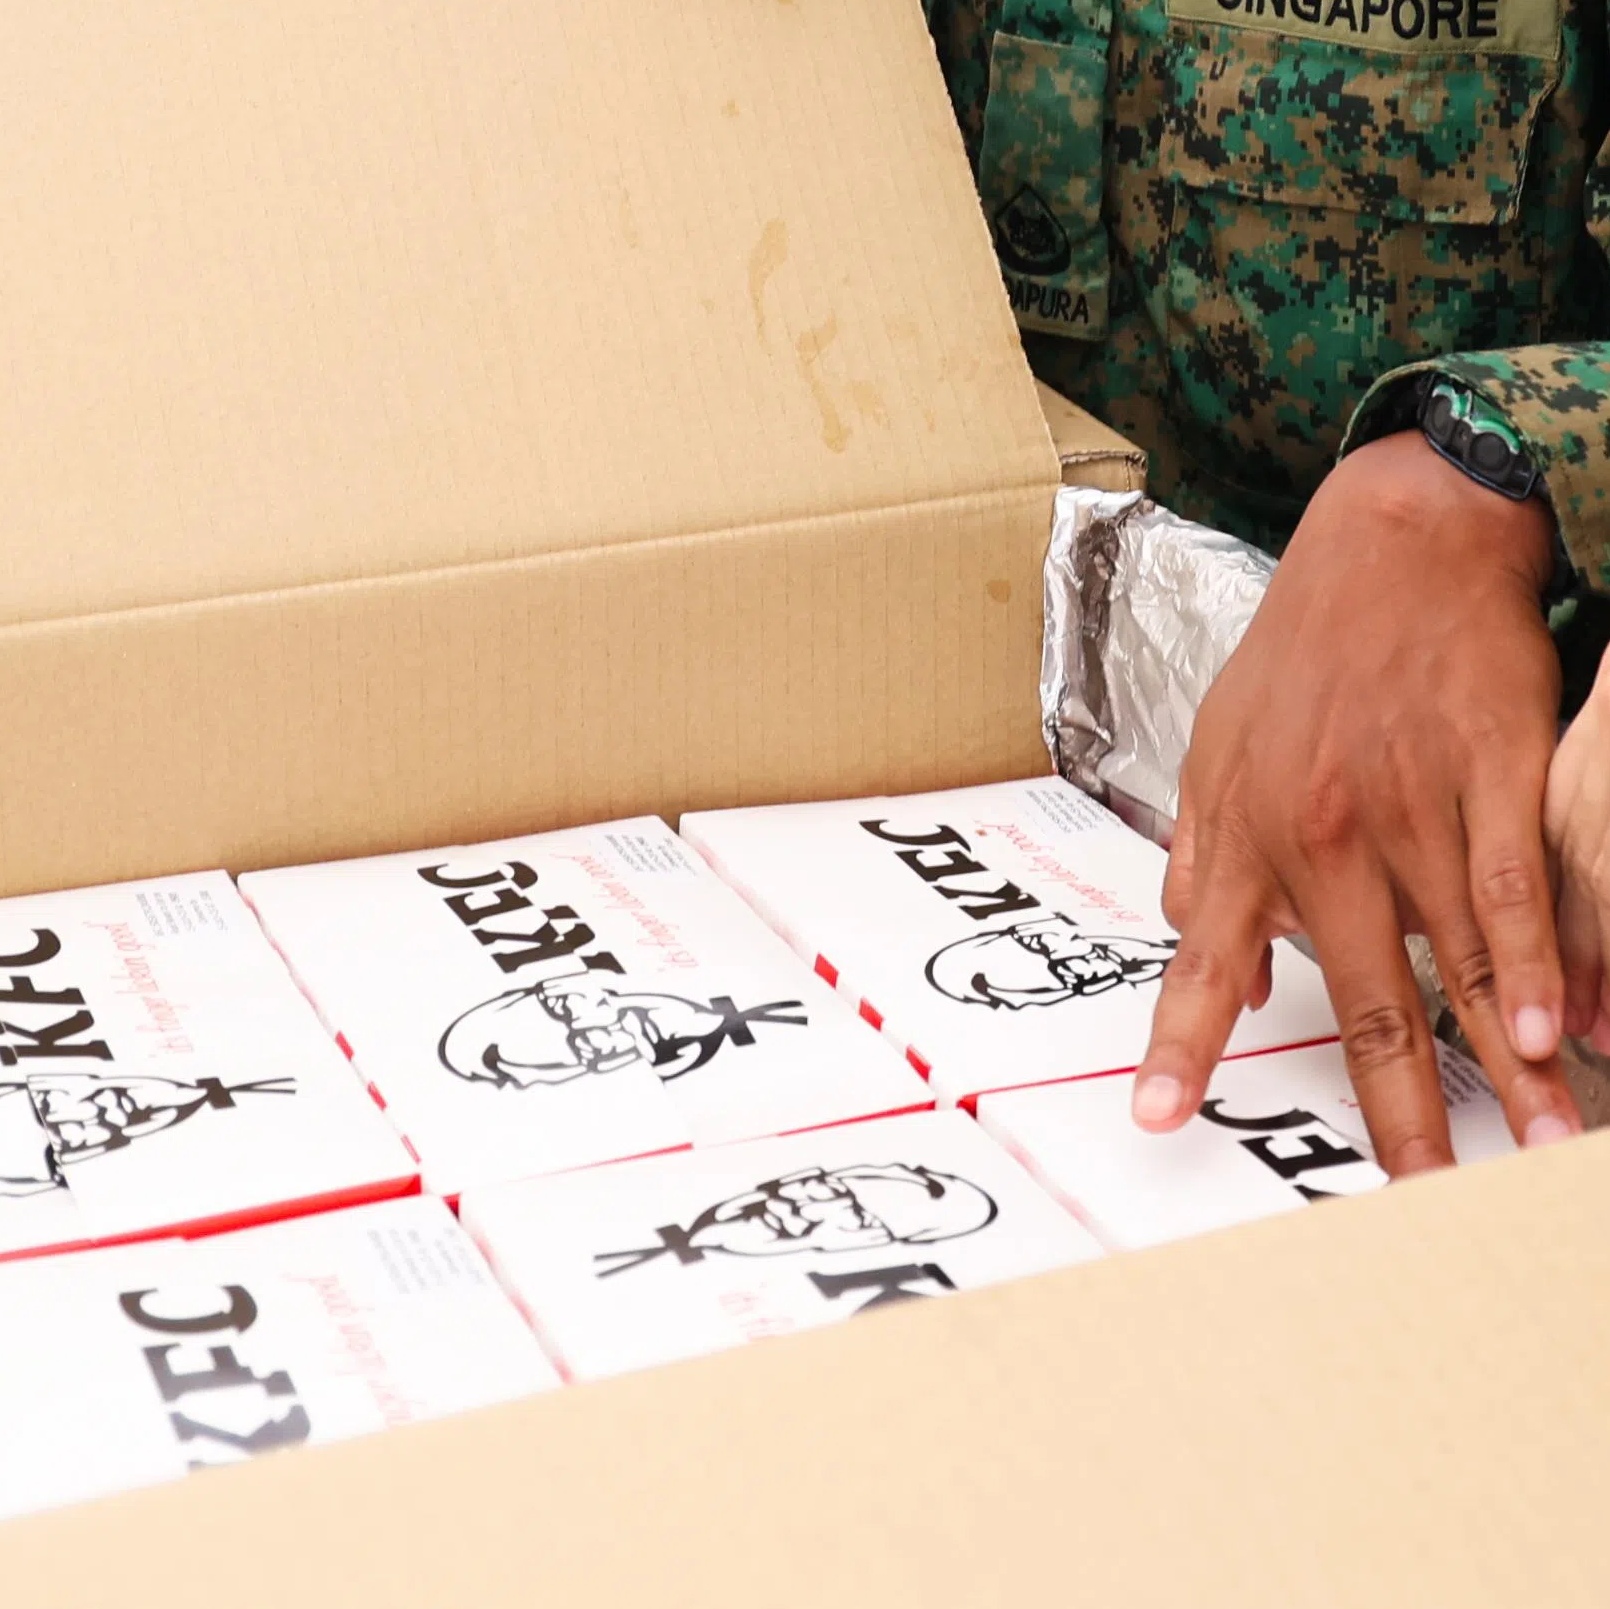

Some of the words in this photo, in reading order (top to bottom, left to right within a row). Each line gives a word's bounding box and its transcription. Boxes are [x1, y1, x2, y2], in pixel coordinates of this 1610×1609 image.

[1003, 274, 1090, 325] APURA
[417, 861, 627, 975] KFC
[859, 818, 1079, 927] KFC
[1199, 1097, 1368, 1204] FC
